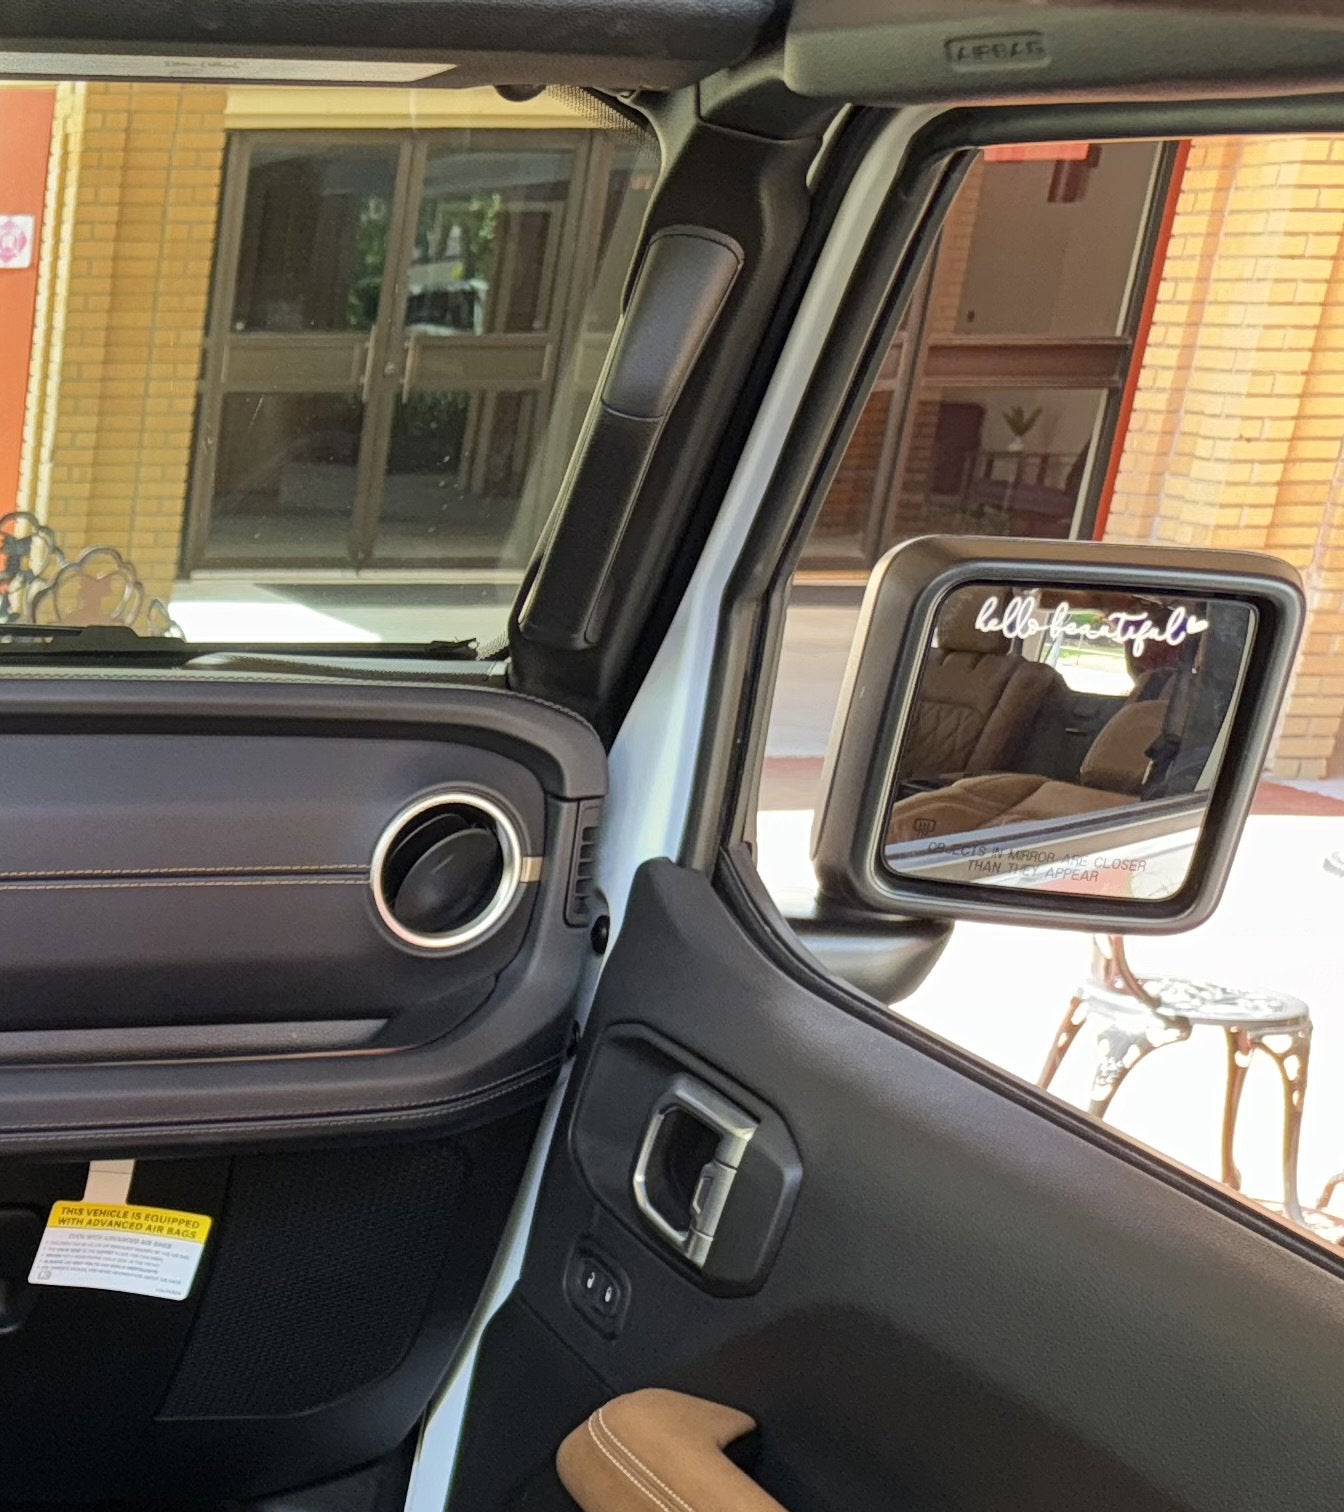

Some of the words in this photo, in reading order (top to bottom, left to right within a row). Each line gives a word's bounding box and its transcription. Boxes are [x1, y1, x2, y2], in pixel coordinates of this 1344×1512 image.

[955, 40, 1046, 62] AIRBAG
[974, 596, 1042, 640] hello
[1049, 601, 1189, 658] beautiful
[927, 841, 986, 857] OBJECTS
[1008, 850, 1056, 863] MIRROR
[1093, 856, 1147, 873] CLOSER
[967, 859, 1002, 873] THAN
[1044, 867, 1100, 882] APPEAR
[58, 1217, 83, 1226] WITH
[86, 1218, 143, 1231] ADVANCED
[145, 1224, 164, 1233] AIR
[167, 1228, 197, 1240] BAGS
[62, 1207, 84, 1216] THIS
[86, 1208, 129, 1220] VEHICLE
[131, 1212, 141, 1220] IS
[144, 1214, 200, 1229] EQUIPPED
